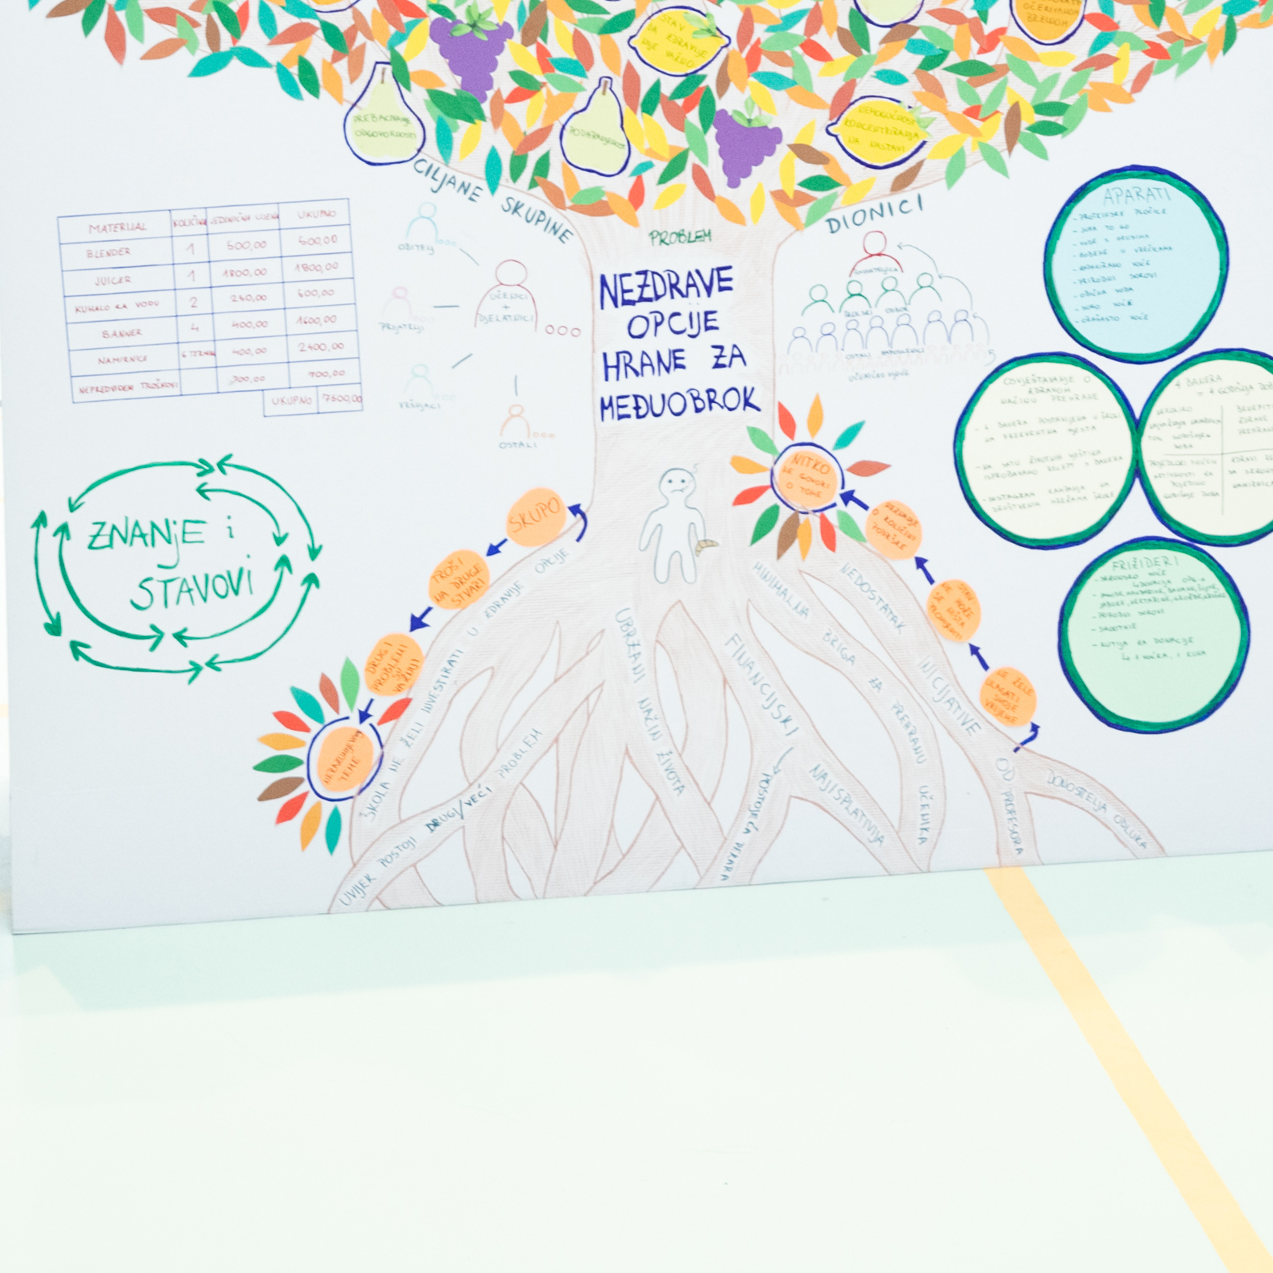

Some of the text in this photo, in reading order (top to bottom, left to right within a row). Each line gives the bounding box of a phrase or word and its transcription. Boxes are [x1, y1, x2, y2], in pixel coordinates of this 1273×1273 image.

[660, 14, 686, 32] STAV
[870, 141, 906, 152] NASTAVI
[412, 157, 575, 245] CILJANE SKUPINE
[1103, 186, 1172, 206] APARATI
[88, 209, 337, 235] MATERIJAL UKUPNO
[825, 193, 923, 234] DIONICI
[86, 234, 338, 259] BLENDER 1 500,00 500,00
[648, 228, 712, 247] PROBLEM
[95, 261, 339, 286] JUICER 1 1800,00 1800,00
[489, 290, 529, 301] UČENICI
[600, 265, 734, 311] NEZDRAVE
[75, 303, 111, 314] KUHALO
[190, 296, 198, 309] 2
[477, 312, 535, 324] DJELATNICI
[102, 314, 337, 339] BANNER 4 400,00 1600,00
[627, 302, 720, 340] OPCIJE
[98, 341, 345, 365] NAMIRNICE 400,00 2400,00
[602, 343, 747, 382] HRANE ZA
[308, 368, 346, 379] 700,00
[1084, 375, 1092, 383] O
[272, 392, 363, 407] UKUPNO 7500,00
[600, 386, 762, 423] MEĐUOBROK
[499, 441, 538, 450] OSTALI
[792, 452, 831, 475] NITKO
[782, 466, 830, 490] NE GOVORI
[786, 481, 822, 499] O TOME
[226, 515, 235, 539] i
[507, 496, 561, 534] SKUPO
[433, 557, 464, 585] TROŠI
[1112, 555, 1179, 572] FRIŽIDERI
[434, 564, 484, 604] NA DRUGE
[450, 577, 486, 607] STVARI
[371, 643, 408, 692] PROBLEMI
[358, 548, 569, 823] ŠKOLA NE ŽELI INVESTIRATI U ZDRAVIJE OPCIJE
[724, 633, 800, 737] FINANCIJSKI
[614, 607, 686, 796] UBRZANI NAČIN ŽIVOTA
[752, 561, 934, 845] MINIMALNA BRIGA ZA PREHRANU UČENIKA
[838, 563, 1024, 855] NEDOSTATAK INICIJATIVE OD PROFESORA
[339, 756, 360, 783] TEME
[339, 728, 543, 907] UVIJEK POSTOJI DRUGI/VEĆI PROBLEM
[808, 763, 886, 846] NAJISPLATIVIJA
[720, 842, 744, 882] PEKARA
